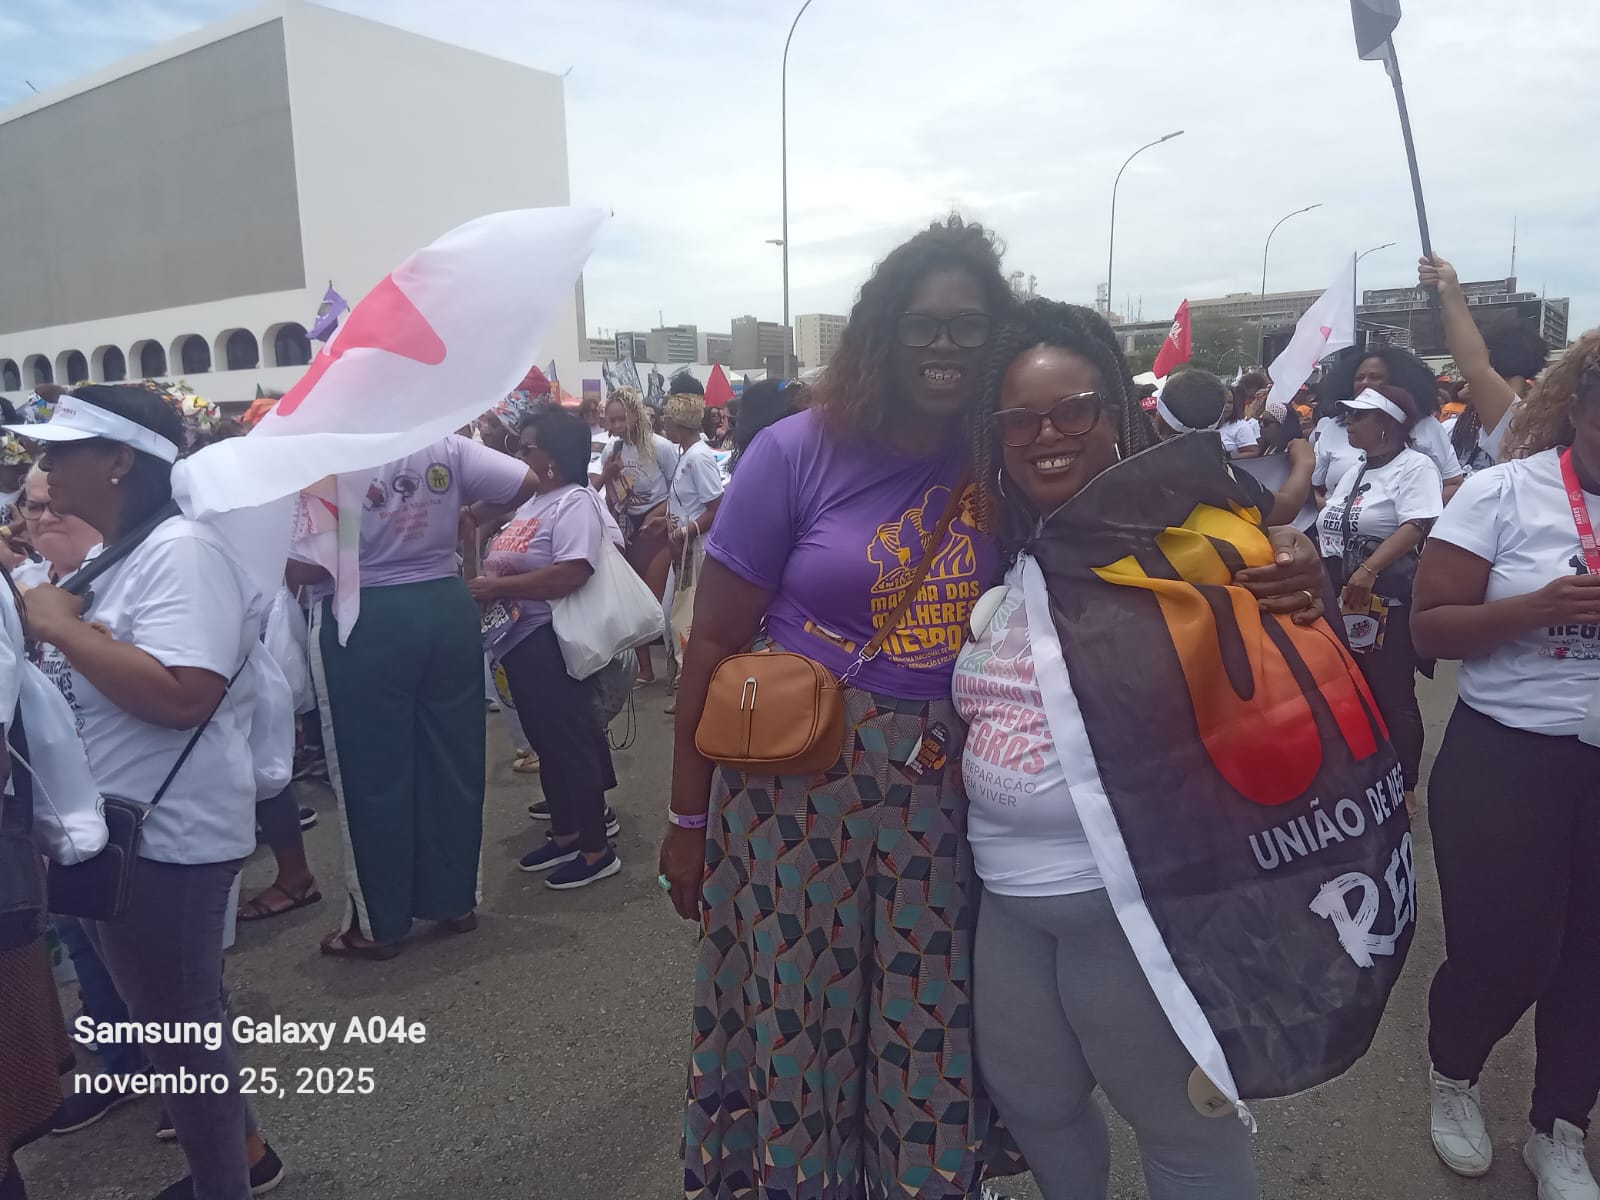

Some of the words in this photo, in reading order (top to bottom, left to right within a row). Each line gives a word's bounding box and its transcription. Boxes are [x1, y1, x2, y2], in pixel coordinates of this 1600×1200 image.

[1323, 520, 1359, 533] NEGS
[1324, 512, 1360, 521] MULES
[871, 584, 939, 612] MARHA
[945, 580, 980, 600] DAS
[881, 625, 970, 656] NEGRA
[1548, 623, 1600, 640] NEG
[955, 673, 1026, 704] MARCHA
[957, 696, 1053, 740] MULHERE
[964, 719, 1052, 775] EGRAS
[965, 759, 1037, 794] REPARAÇÃO
[980, 785, 1018, 808] VIVER
[1248, 798, 1366, 870] UNIÃO
[1365, 780, 1391, 825] DE
